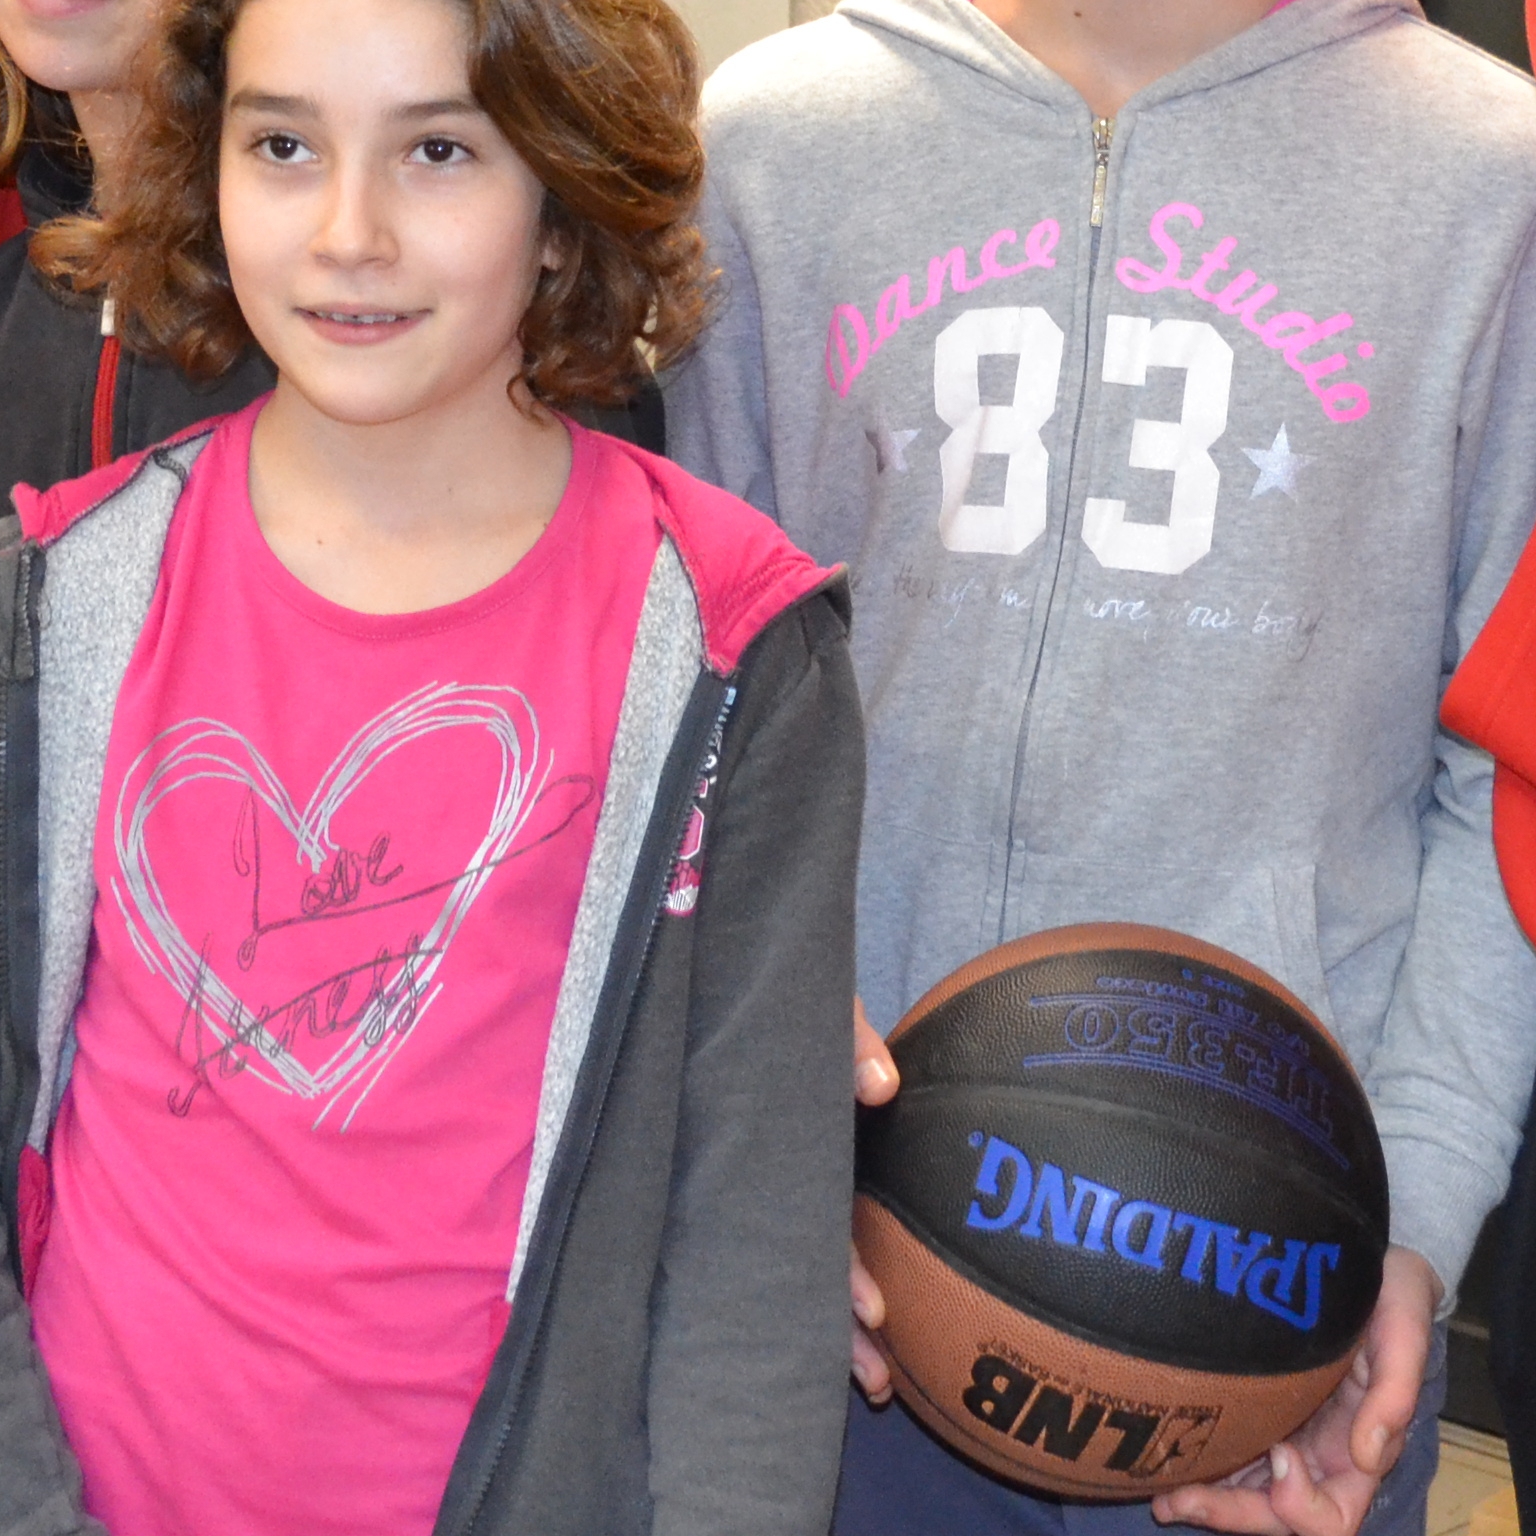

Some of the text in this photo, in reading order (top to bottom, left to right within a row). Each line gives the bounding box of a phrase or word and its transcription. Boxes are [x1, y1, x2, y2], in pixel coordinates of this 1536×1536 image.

[825, 201, 1375, 423] Dance Studio
[933, 306, 1234, 575] 83
[966, 1134, 1341, 1333] SPALDING
[963, 1353, 1160, 1474] LNB
